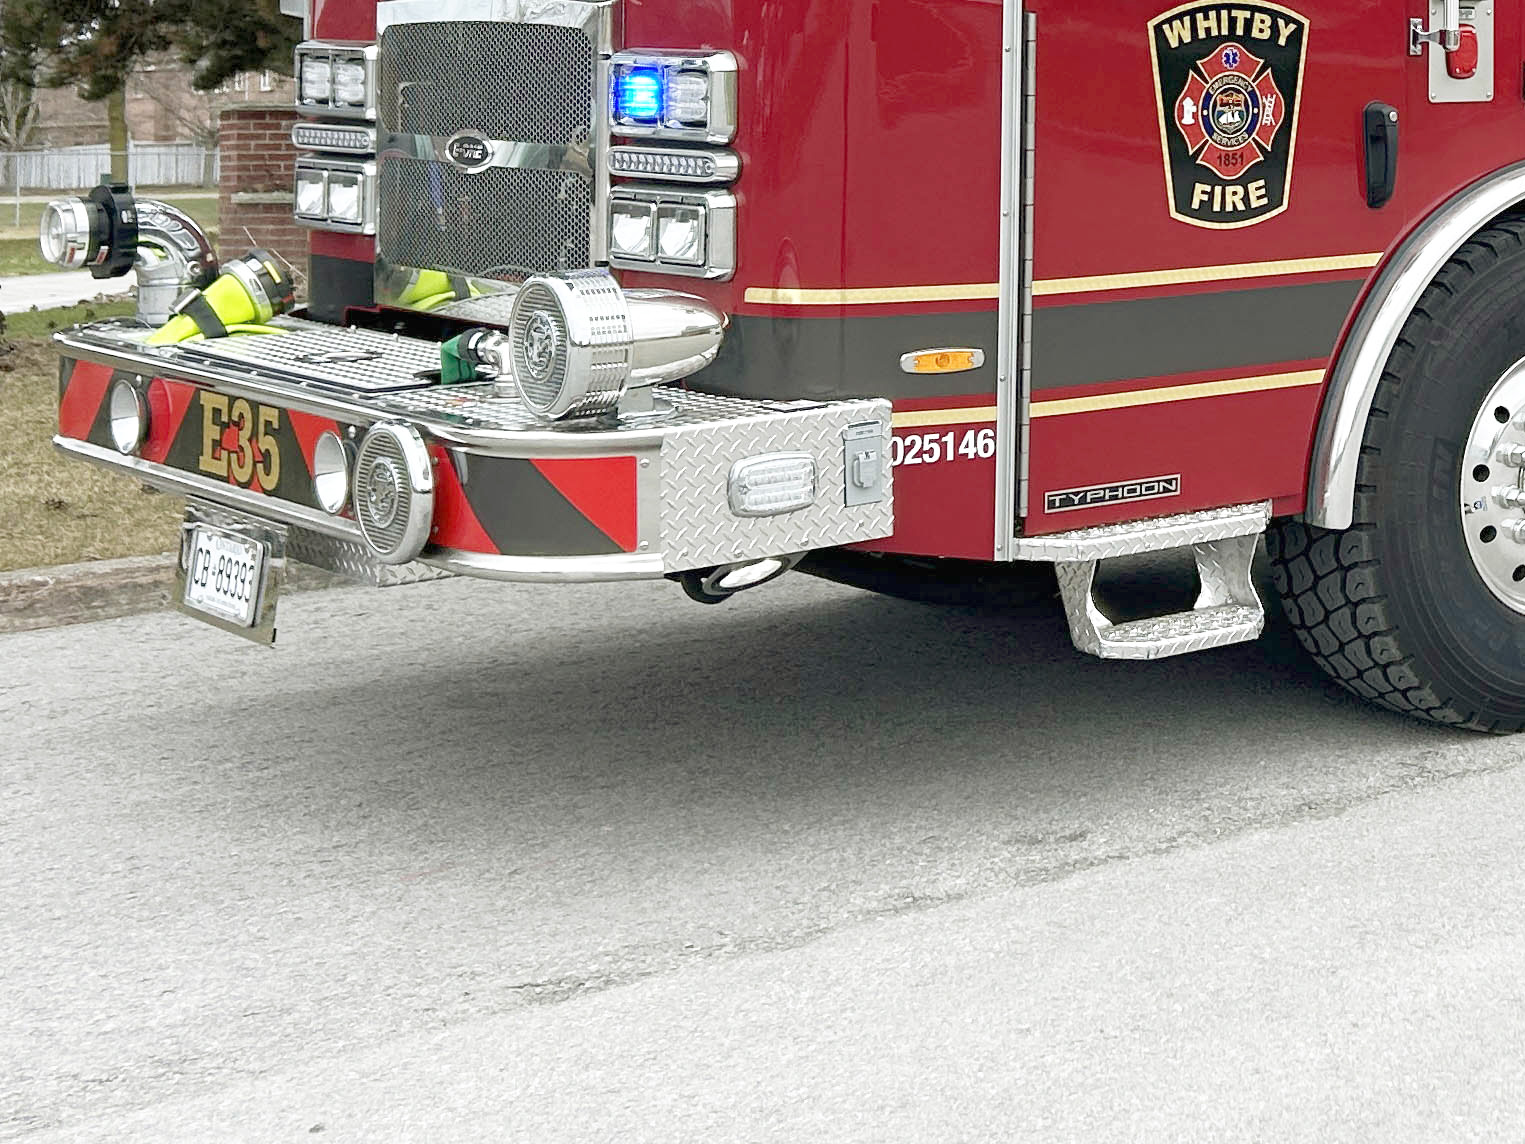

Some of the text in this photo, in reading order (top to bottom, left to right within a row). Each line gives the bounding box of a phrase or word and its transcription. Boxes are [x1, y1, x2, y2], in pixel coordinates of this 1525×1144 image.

[1162, 9, 1297, 49] WHITBY
[1208, 75, 1254, 95] EMERGENCY
[1211, 131, 1249, 147] SERVICES
[1216, 152, 1245, 168] 1851
[1191, 178, 1269, 212] FIRE
[198, 389, 281, 492] E35
[1048, 479, 1177, 508] TYPHOON
[193, 547, 255, 603] CB 89393
